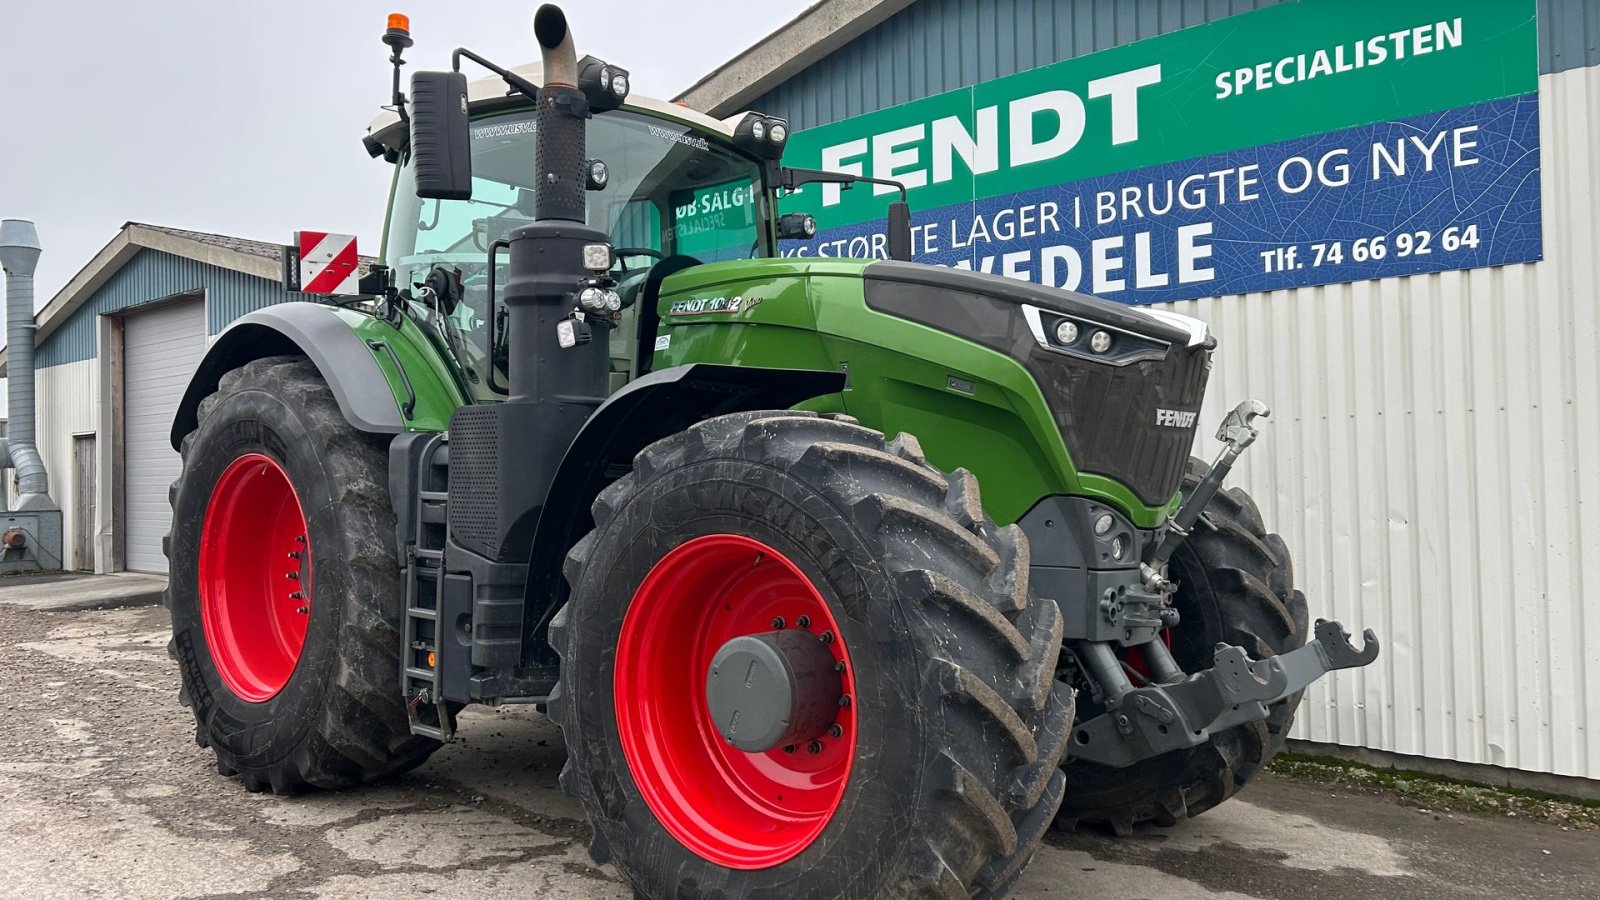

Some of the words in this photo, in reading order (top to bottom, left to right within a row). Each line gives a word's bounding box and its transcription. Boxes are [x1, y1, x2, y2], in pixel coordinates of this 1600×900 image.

[821, 63, 1162, 207] FENDT
[1215, 17, 1463, 99] SPECIALISTEN
[474, 121, 537, 139] www.usv.d
[818, 222, 939, 259] STØRTE
[951, 201, 1061, 249] LAGER
[1074, 196, 1081, 229] I
[1096, 162, 1261, 226] BRUGTE
[1277, 148, 1351, 194] OG
[1371, 124, 1480, 181] NYE
[1260, 245, 1303, 273] Tlf.
[1310, 241, 1344, 267] 74
[1352, 236, 1387, 262] 66
[1395, 230, 1433, 257] 92
[1441, 224, 1480, 252] 64
[670, 298, 710, 314] FENDT
[1155, 408, 1198, 428] FENDT
